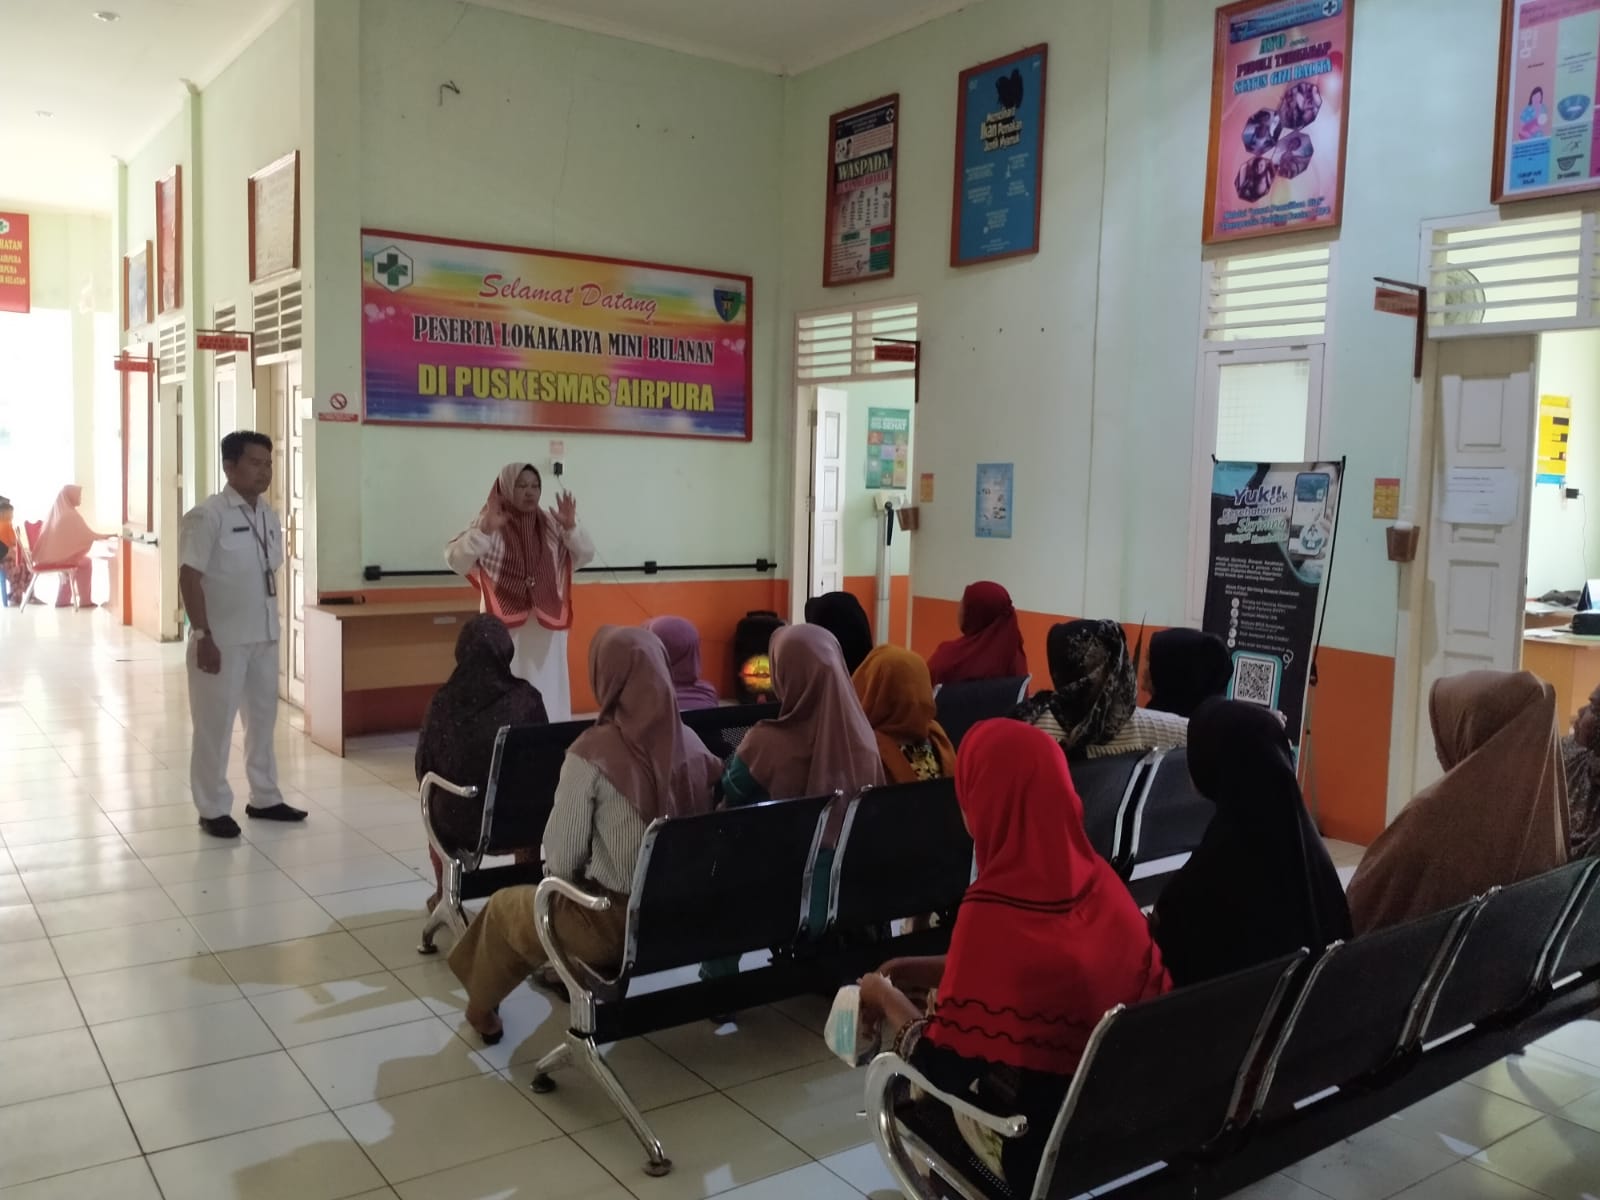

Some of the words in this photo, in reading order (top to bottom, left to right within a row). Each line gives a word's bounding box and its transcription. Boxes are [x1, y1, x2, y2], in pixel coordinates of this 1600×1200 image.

[838, 152, 889, 180] WASPADA
[479, 274, 574, 303] Selamat
[580, 283, 658, 319] Datang
[414, 314, 495, 346] PESERTA
[501, 322, 602, 355] LOKAKARYA
[608, 333, 643, 358] MINI
[648, 337, 714, 364] BULANAN
[418, 363, 448, 396] DI
[455, 365, 611, 406] PUSKESMAS
[615, 377, 715, 412] AIRPURA
